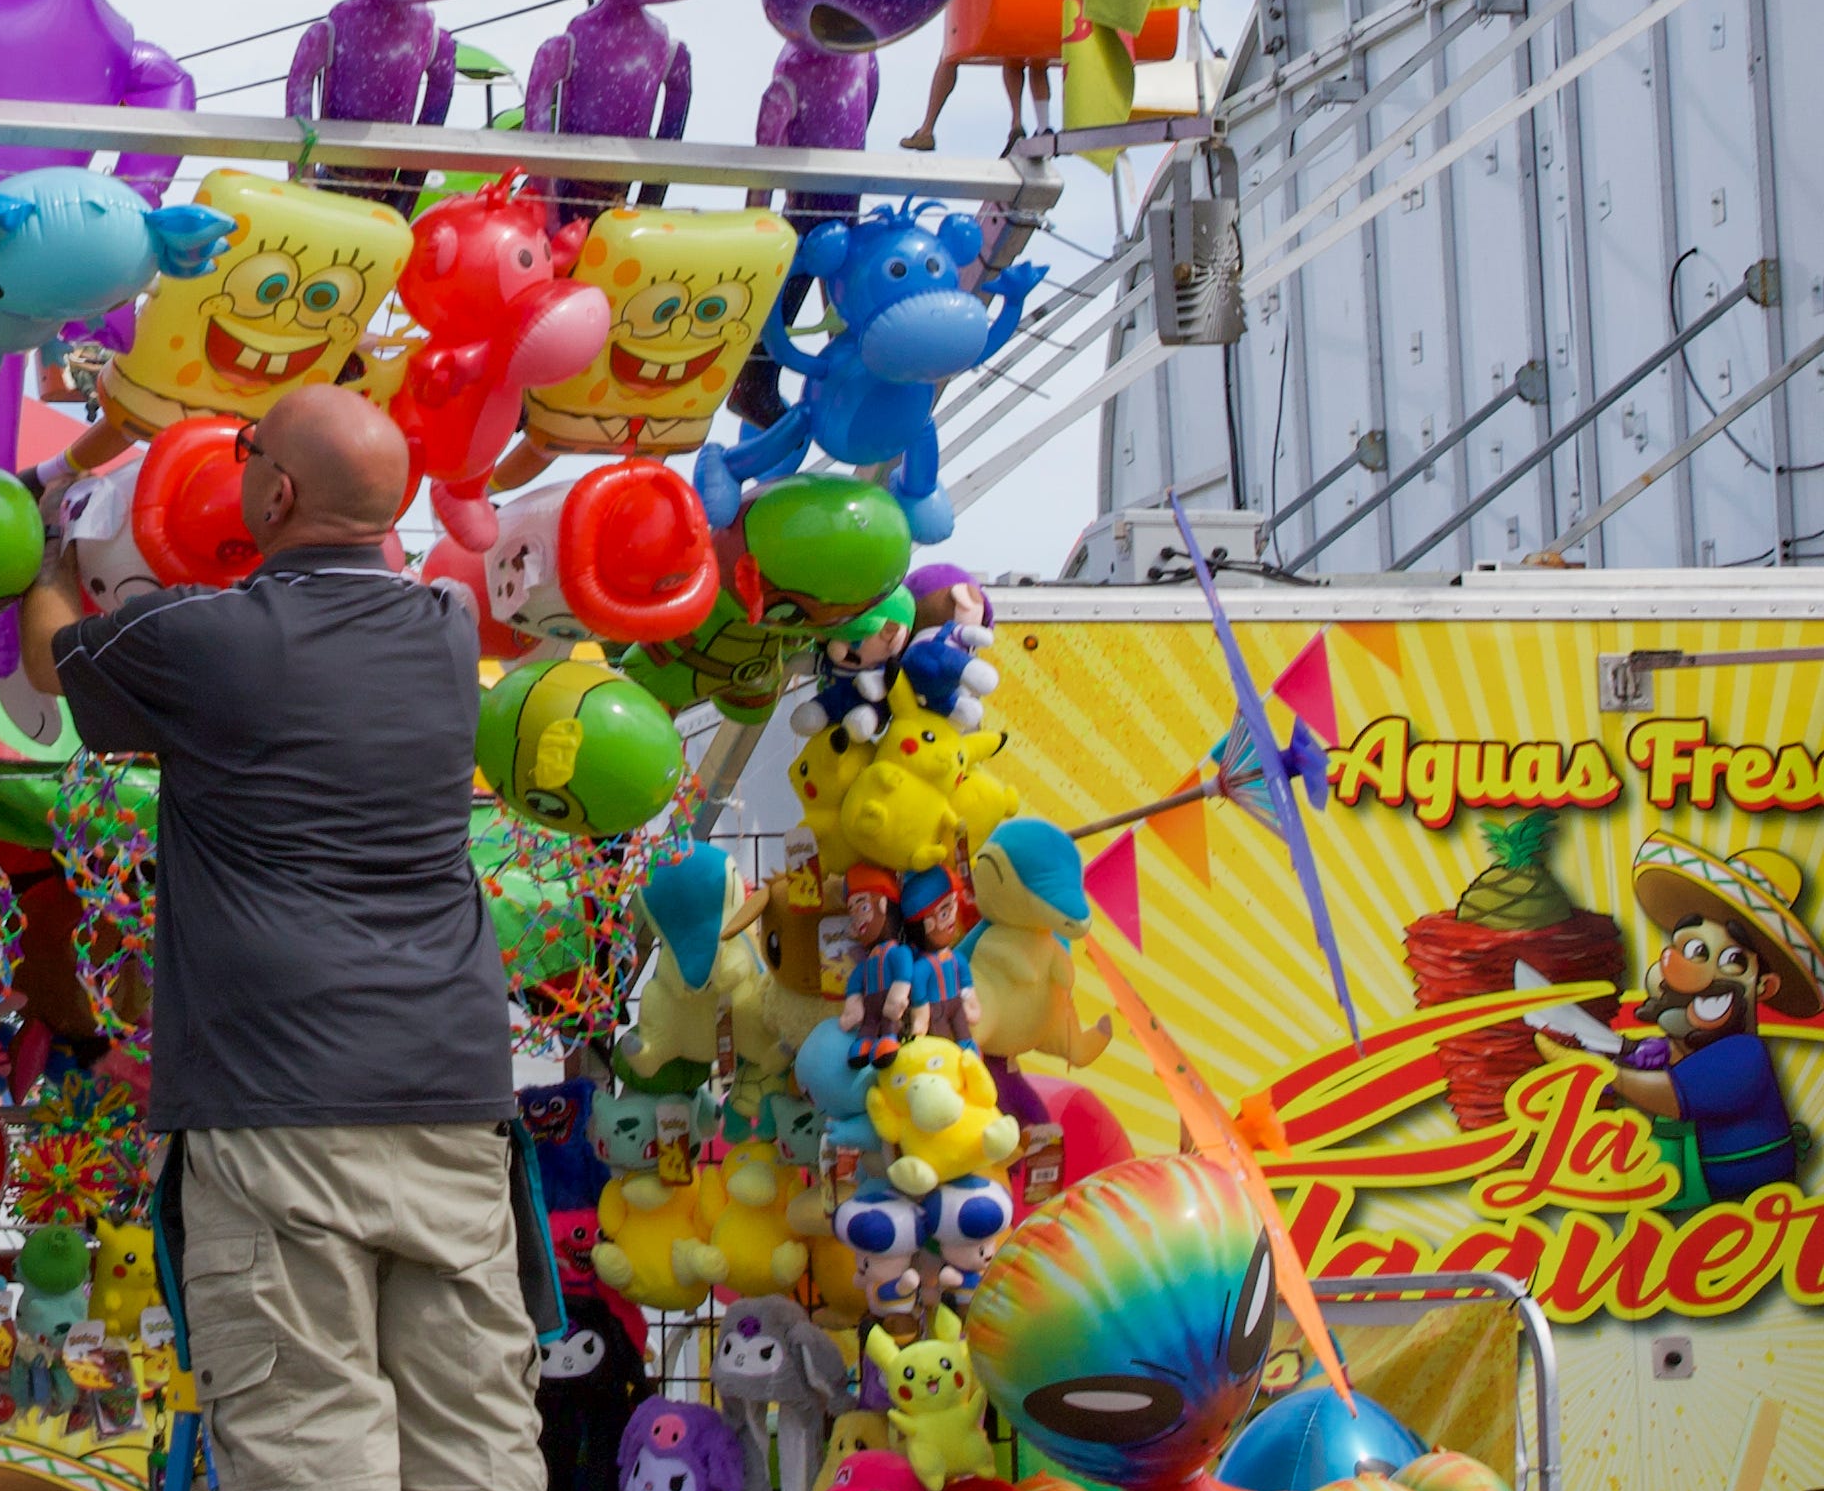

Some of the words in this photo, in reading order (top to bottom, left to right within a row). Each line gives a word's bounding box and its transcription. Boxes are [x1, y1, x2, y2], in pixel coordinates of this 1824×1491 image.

[1328, 716, 1623, 829] Aguas
[1628, 716, 1824, 811] Fres
[1479, 1060, 1670, 1211] La
